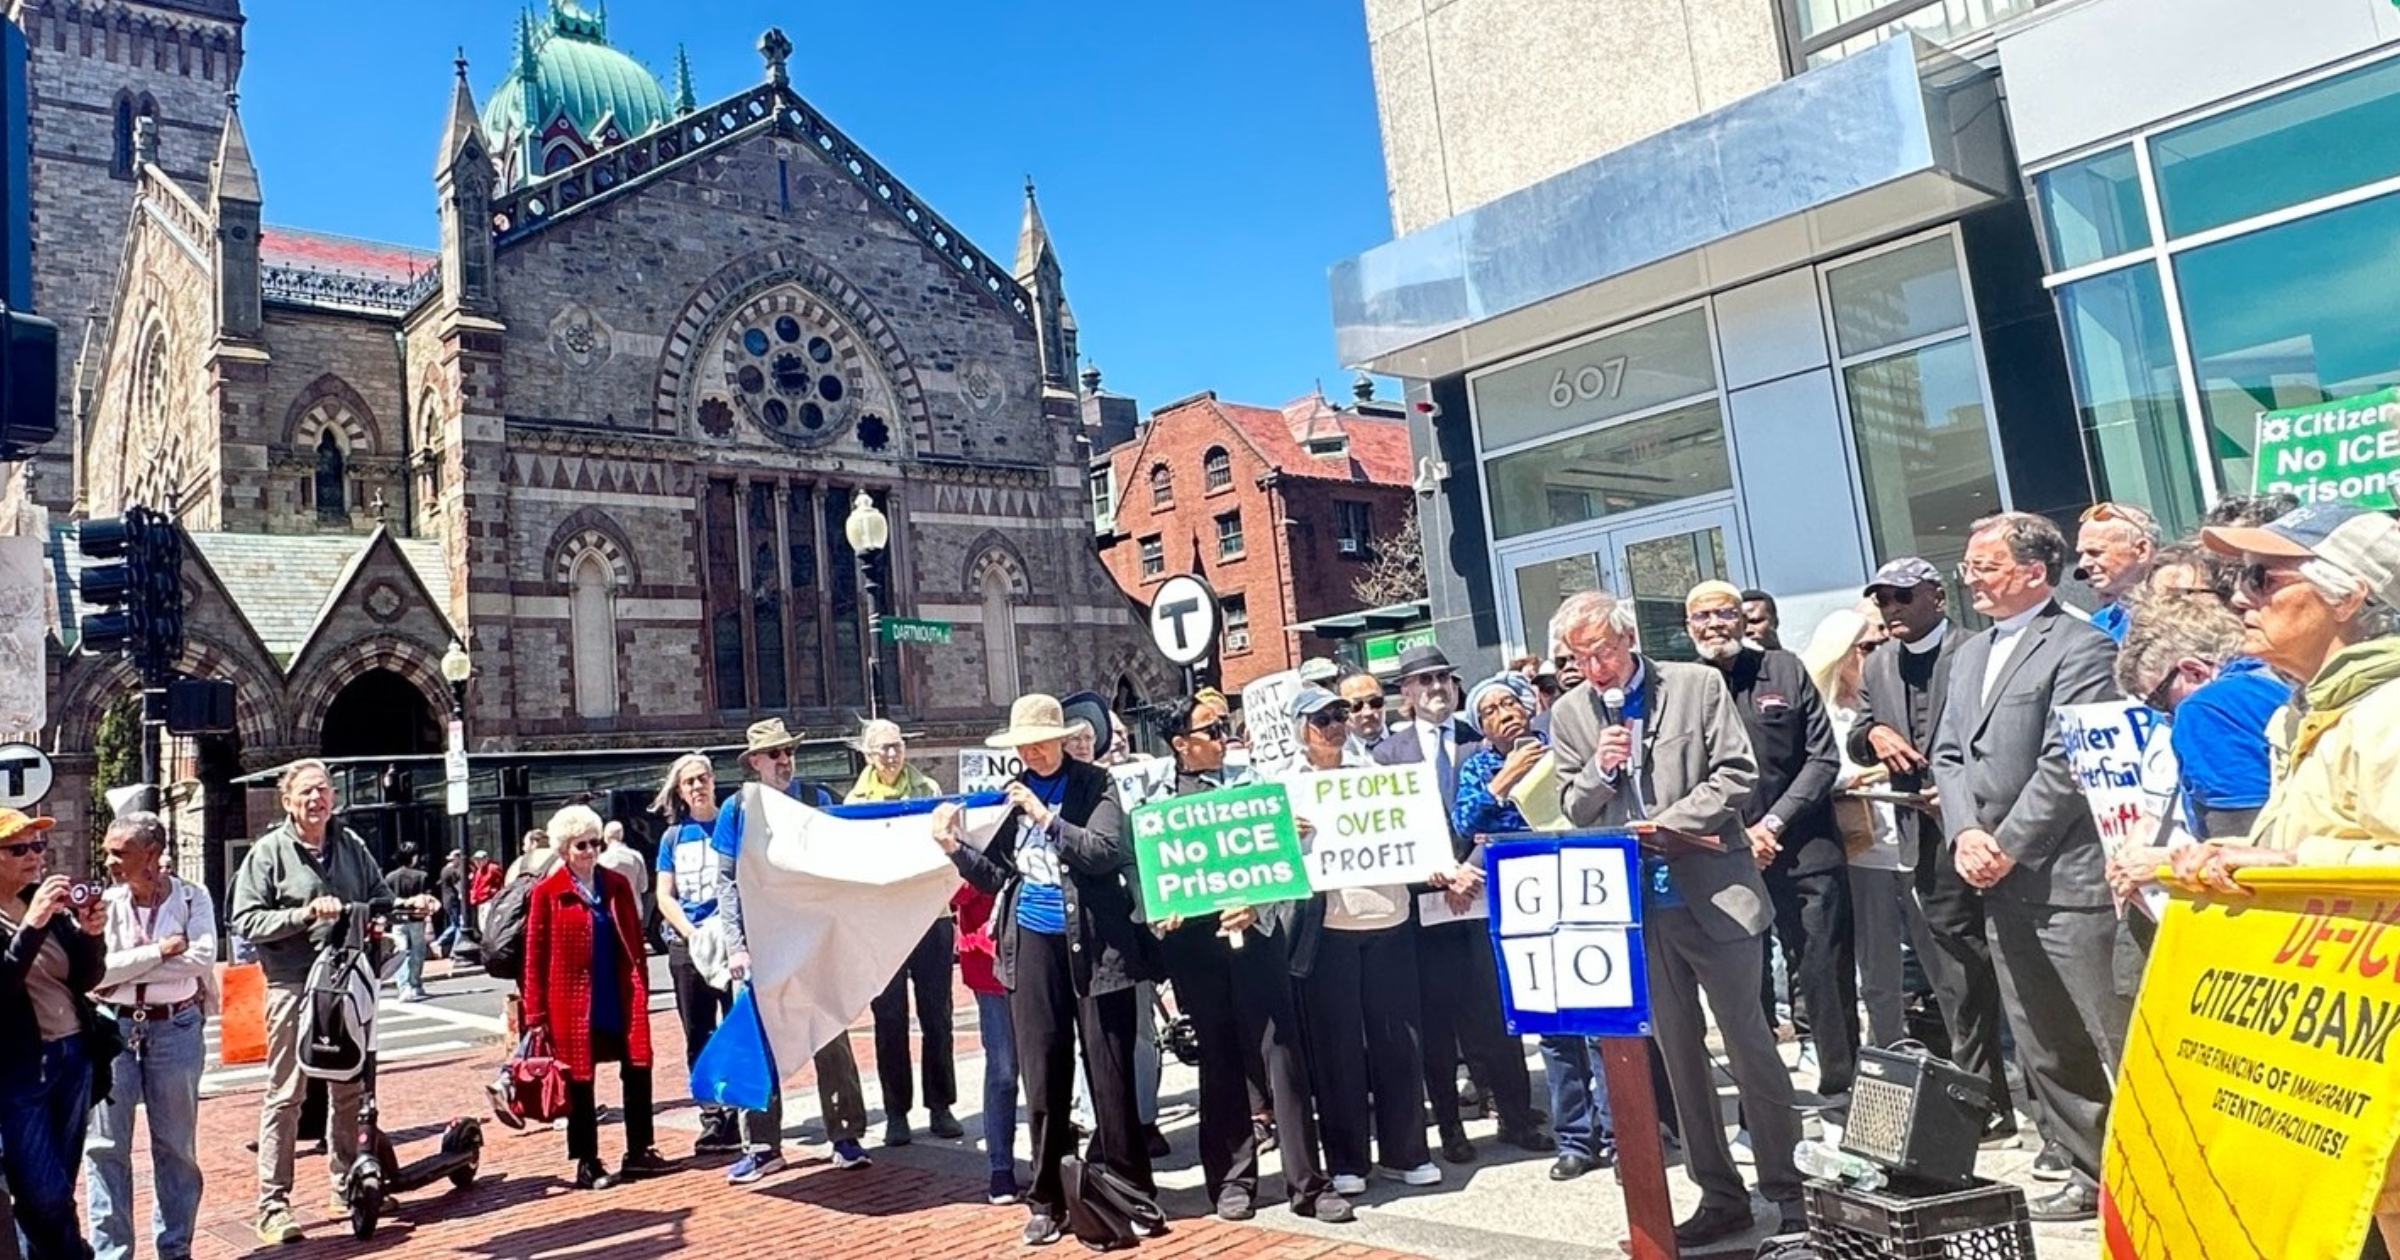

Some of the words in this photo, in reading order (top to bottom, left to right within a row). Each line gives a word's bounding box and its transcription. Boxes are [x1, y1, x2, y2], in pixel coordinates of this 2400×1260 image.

[1549, 356, 1628, 409] 607
[2294, 403, 2397, 438] Citizen
[2277, 447, 2327, 475] No
[2337, 429, 2400, 466] ICE
[1159, 596, 1199, 650] T
[1250, 702, 1292, 731] ANK
[0, 757, 40, 797] T
[986, 755, 1024, 777] NO
[1315, 771, 1420, 804] PEOPLE
[1167, 796, 1282, 831] Citizens
[1336, 807, 1407, 837] OVER
[1158, 838, 1208, 868] No
[1215, 823, 1280, 858] ICE
[1320, 841, 1416, 876] PROFIT
[1156, 861, 1294, 903] Prisons
[2273, 898, 2400, 984] DE-IC
[2190, 968, 2300, 1036] CITIZENS
[2290, 986, 2400, 1064] BANK
[2210, 1048, 2265, 1084] FINANCING
[2267, 1066, 2291, 1093] OF
[2289, 1074, 2371, 1118] IMMIGRANT
[2212, 1088, 2279, 1130] DETENTION
[2272, 1112, 2349, 1159] FACILITIES!
